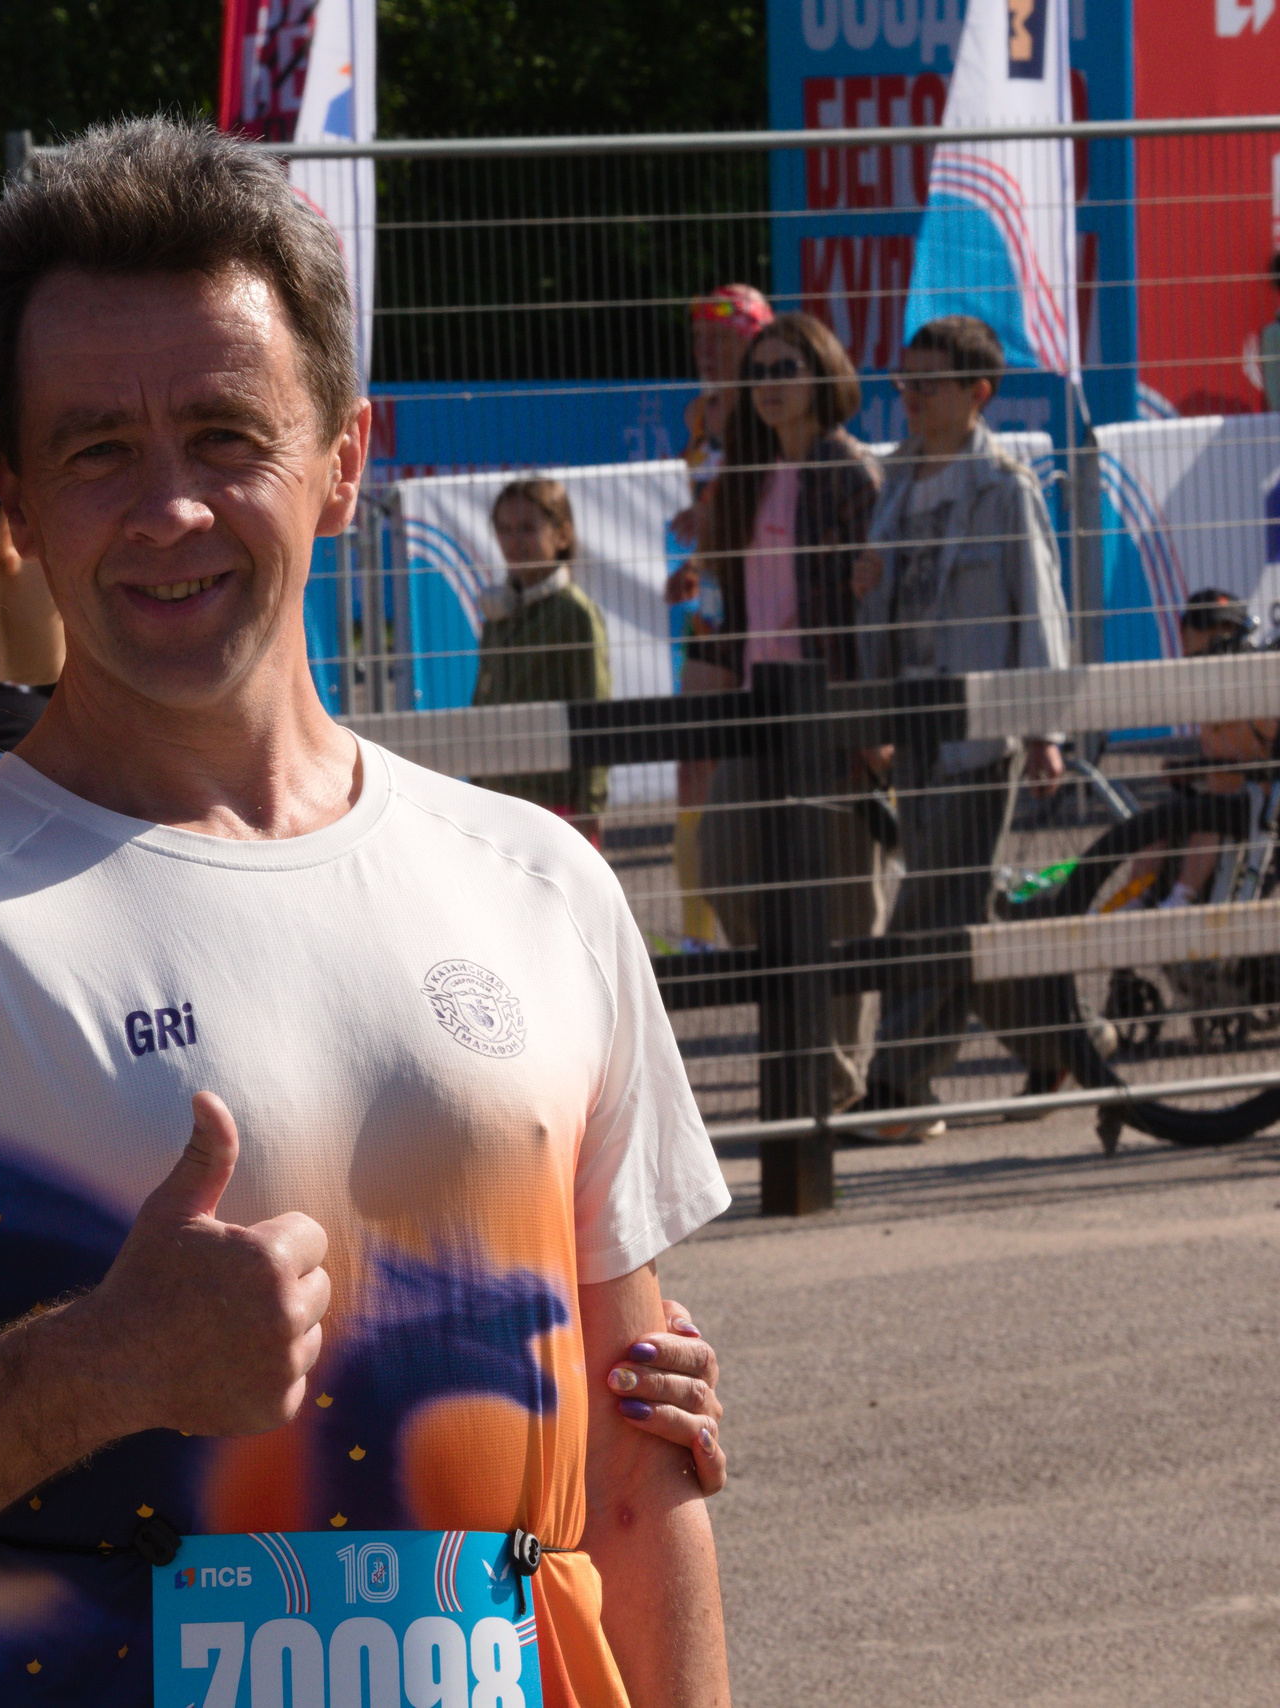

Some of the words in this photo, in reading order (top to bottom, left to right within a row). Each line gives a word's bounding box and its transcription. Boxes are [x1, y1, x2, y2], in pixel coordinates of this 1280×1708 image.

[431, 963, 504, 991] КАЗАНСКИЙ
[125, 1002, 198, 1057] GRi
[461, 1033, 520, 1055] МАРАФОН
[201, 1567, 253, 1588] ПСБ
[336, 1542, 399, 1604] 10
[181, 1616, 526, 1708] 70098
